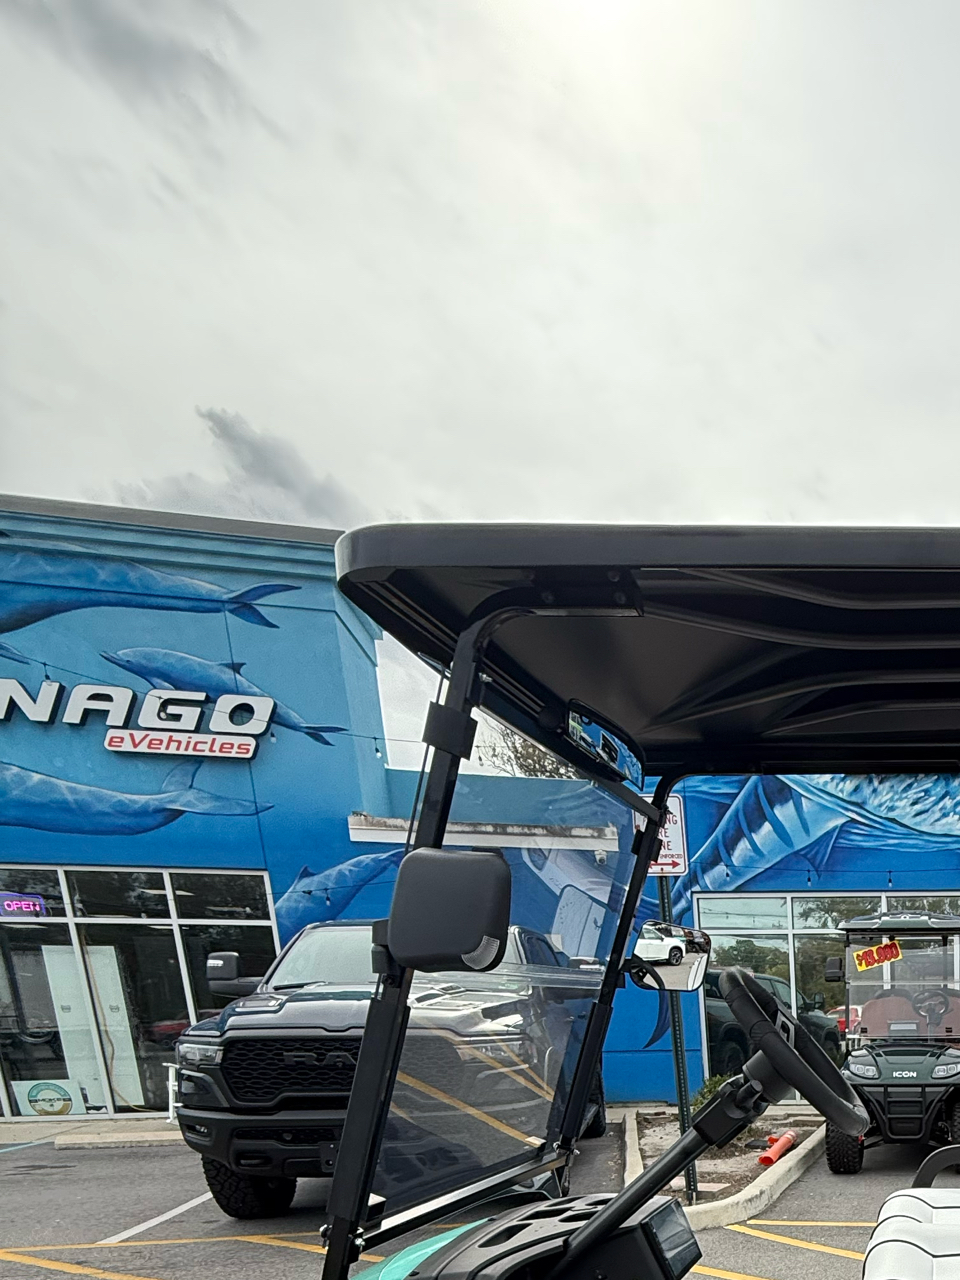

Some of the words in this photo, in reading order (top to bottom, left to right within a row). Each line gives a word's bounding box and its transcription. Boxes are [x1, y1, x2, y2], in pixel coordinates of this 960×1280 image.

[107, 732, 252, 755] eVehicles
[4, 901, 40, 911] OPEN
[283, 1053, 357, 1067] RA
